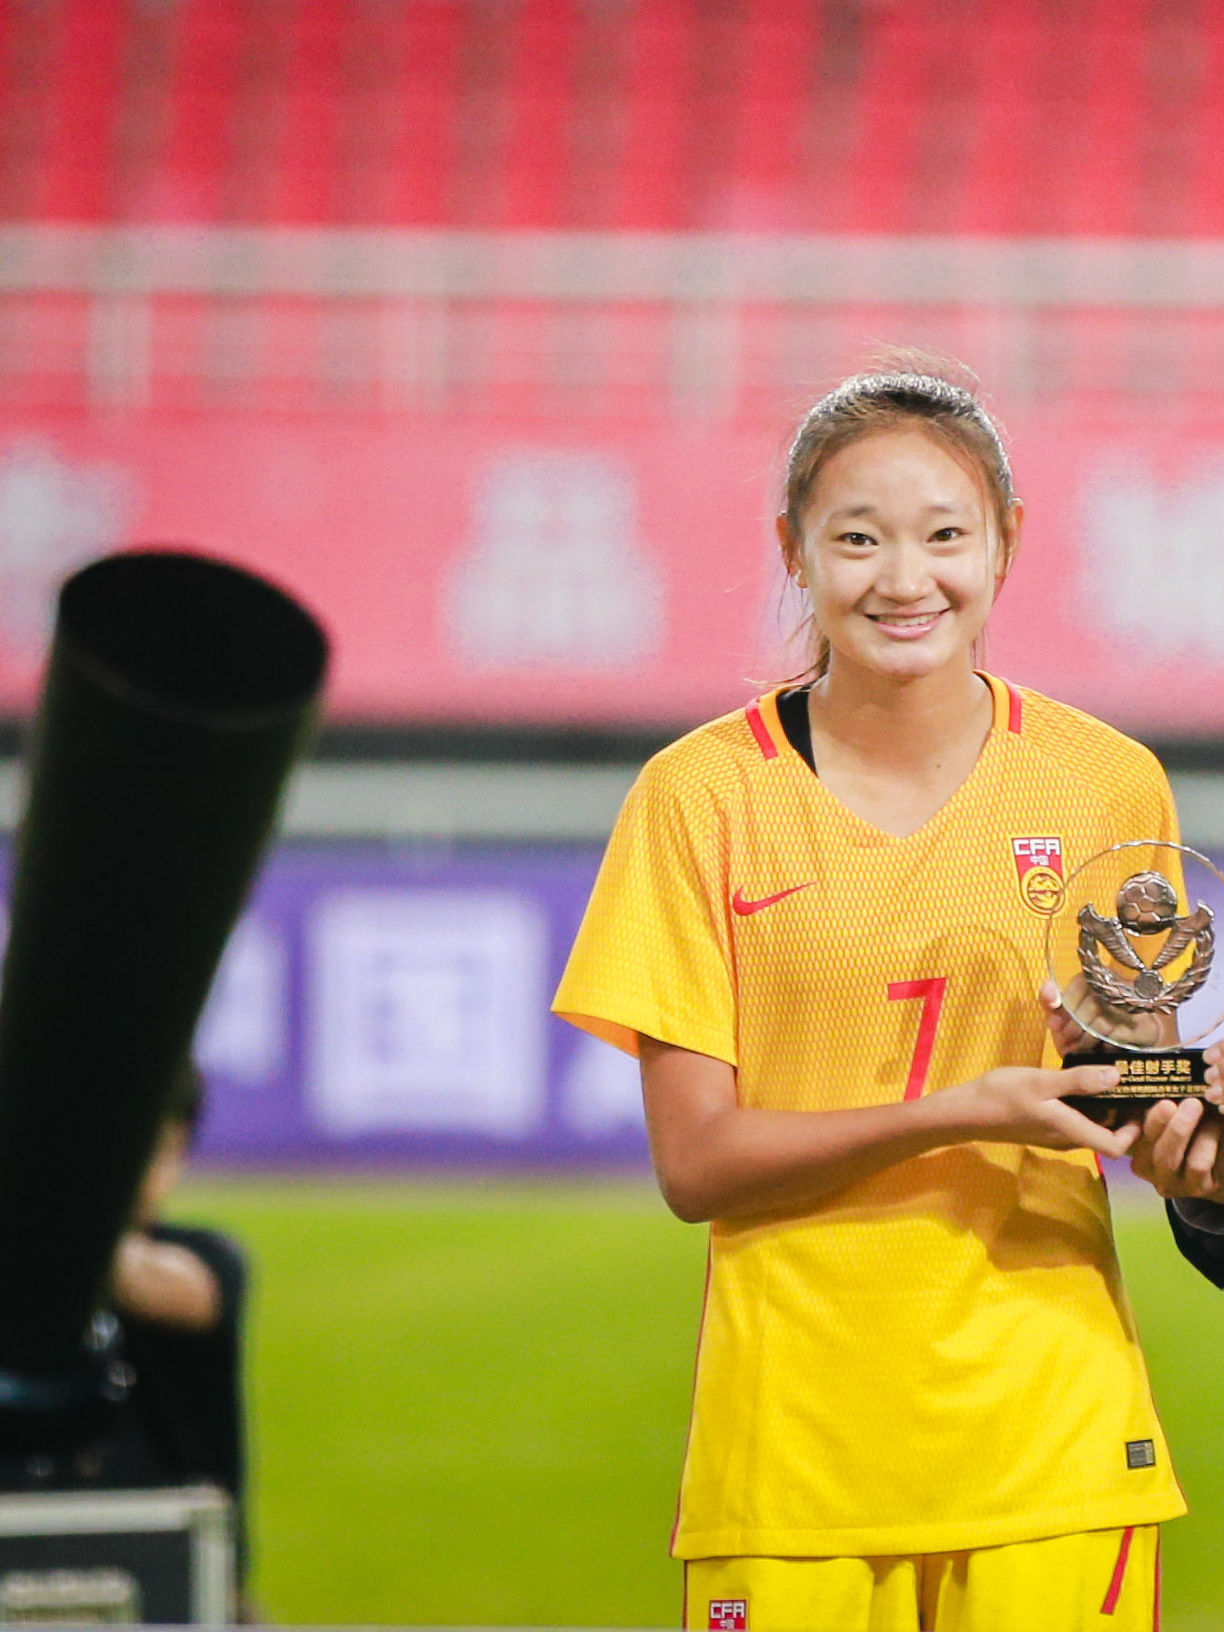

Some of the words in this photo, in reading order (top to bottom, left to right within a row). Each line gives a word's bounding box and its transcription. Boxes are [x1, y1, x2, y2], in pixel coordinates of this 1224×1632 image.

[1013, 838, 1061, 855] CFA
[887, 977, 948, 1103] 7
[710, 1601, 745, 1619] CFA
